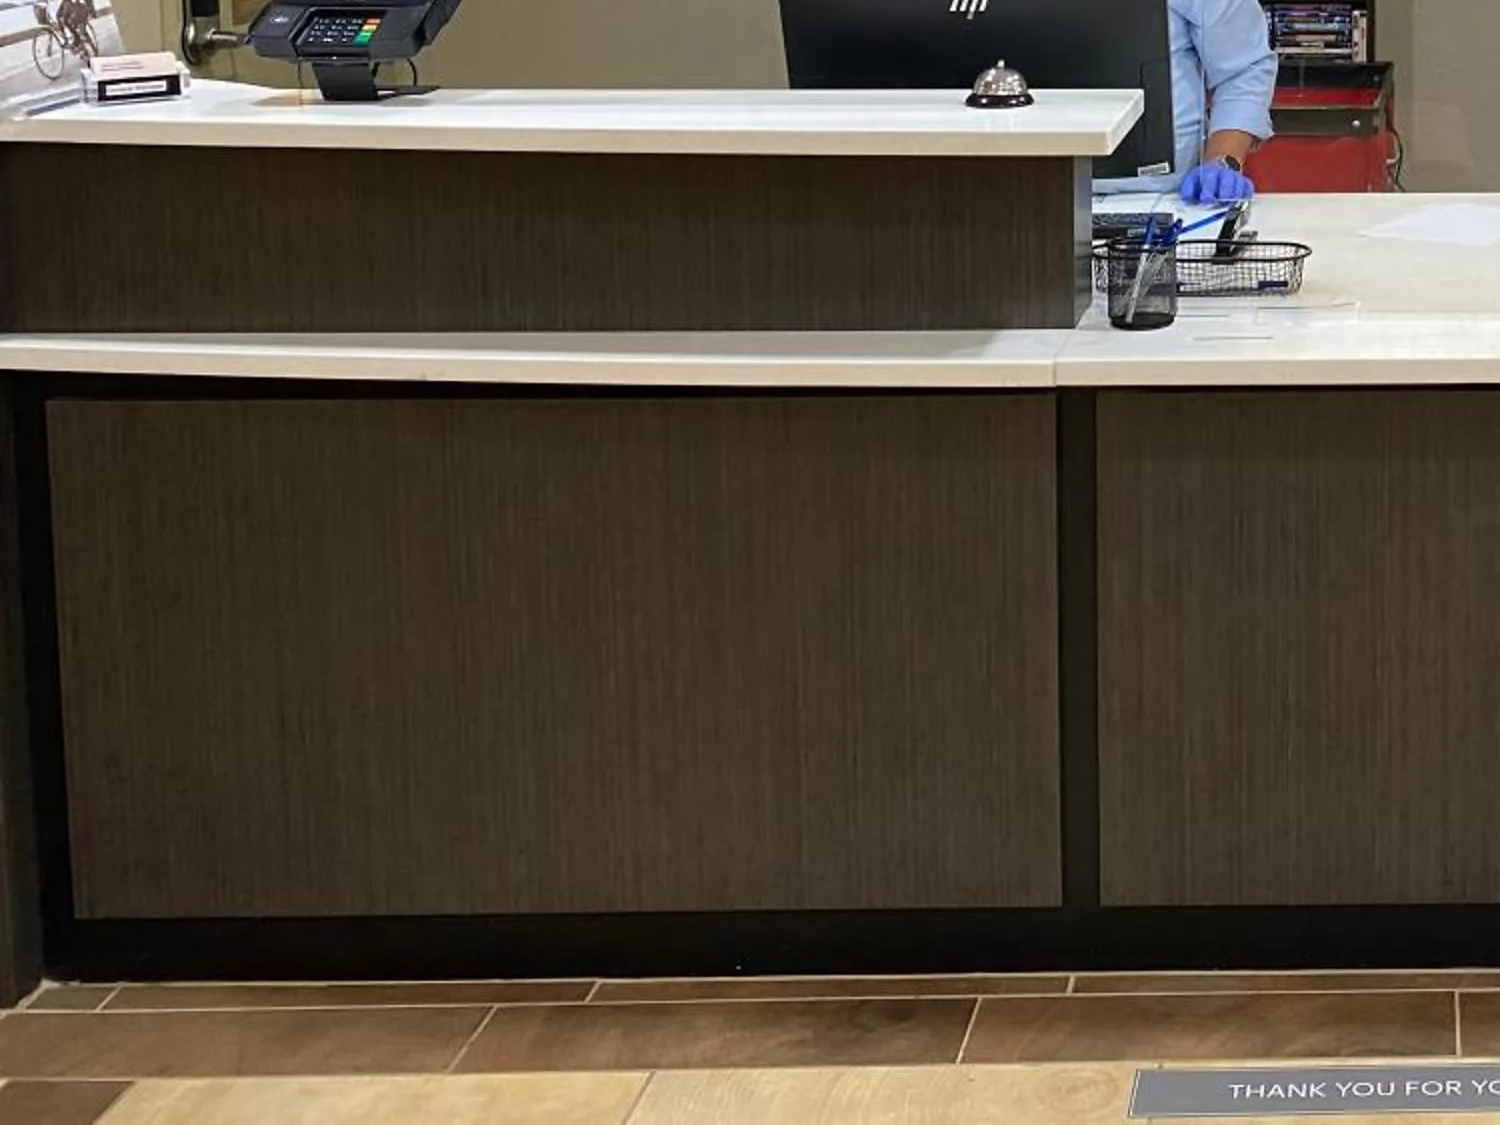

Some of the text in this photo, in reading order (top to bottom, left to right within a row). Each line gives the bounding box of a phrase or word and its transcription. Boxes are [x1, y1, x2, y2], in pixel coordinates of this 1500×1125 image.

[1228, 1082, 1327, 1100] THANK
[1335, 1081, 1396, 1098] YOU
[1404, 1080, 1463, 1096] FOR
